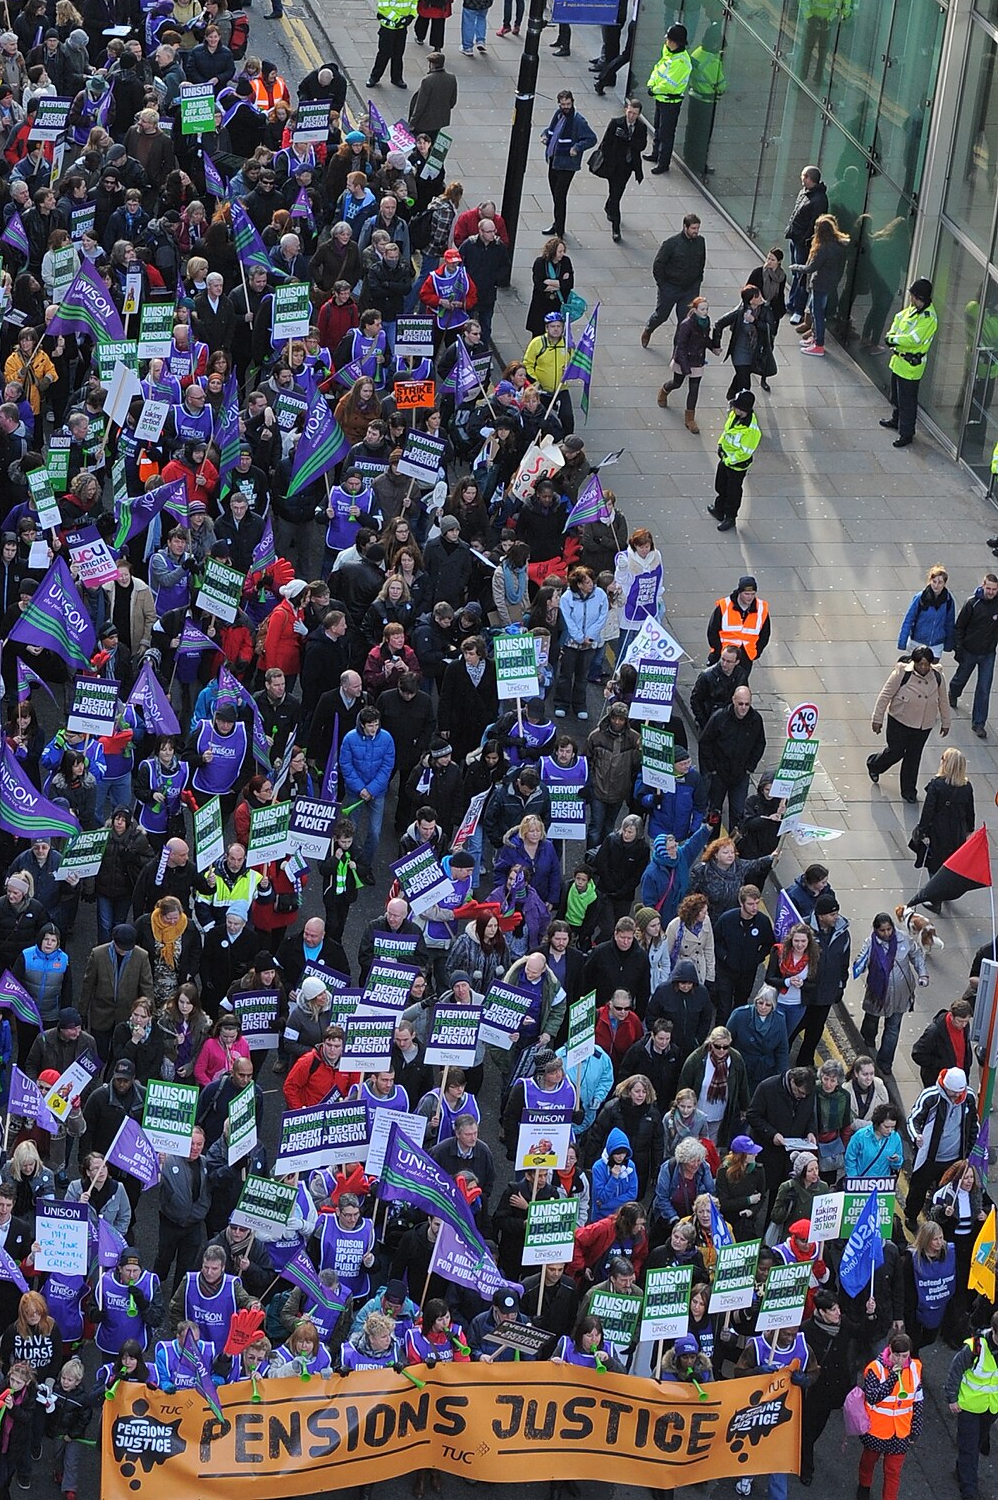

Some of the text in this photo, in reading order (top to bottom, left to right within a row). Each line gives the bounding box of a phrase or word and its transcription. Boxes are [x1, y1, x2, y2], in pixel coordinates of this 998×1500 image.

[183, 85, 213, 97] UNISON
[187, 100, 208, 109] HANDS
[74, 279, 114, 319] UNISON
[396, 386, 433, 396] STRIKE
[396, 395, 426, 404] BACK
[72, 544, 106, 563] UCU
[80, 562, 113, 577] DISPUTE
[48, 585, 87, 635] UNISON
[798, 711, 815, 722] NO
[791, 722, 816, 735] CUTS
[295, 799, 337, 818] OFFICIAL
[294, 815, 332, 832] PICKET
[149, 1084, 196, 1104] UNISON
[147, 1097, 179, 1109] FIGHTING
[147, 1106, 192, 1123] DECENT
[145, 1116, 192, 1134] PENSIONS
[847, 1179, 895, 1191] UNISON
[819, 1198, 833, 1207] I'm
[43, 1206, 81, 1218] UNISON
[530, 1204, 576, 1217] UNISON
[815, 1206, 838, 1216] taking
[814, 1214, 837, 1223] action
[530, 1221, 573, 1235] DECENT
[814, 1223, 822, 1231] 30
[527, 1232, 574, 1244] PENSIONS
[14, 1334, 51, 1347] SAVE
[14, 1345, 53, 1360] NURSE
[159, 1404, 183, 1415] TUC
[199, 1392, 721, 1463] PENSIONS JUSTICE
[730, 1412, 780, 1432] JUSTICE
[118, 1422, 173, 1437] PENSIONS
[116, 1435, 172, 1453] JUSTICE
[441, 1444, 475, 1465] TUC
